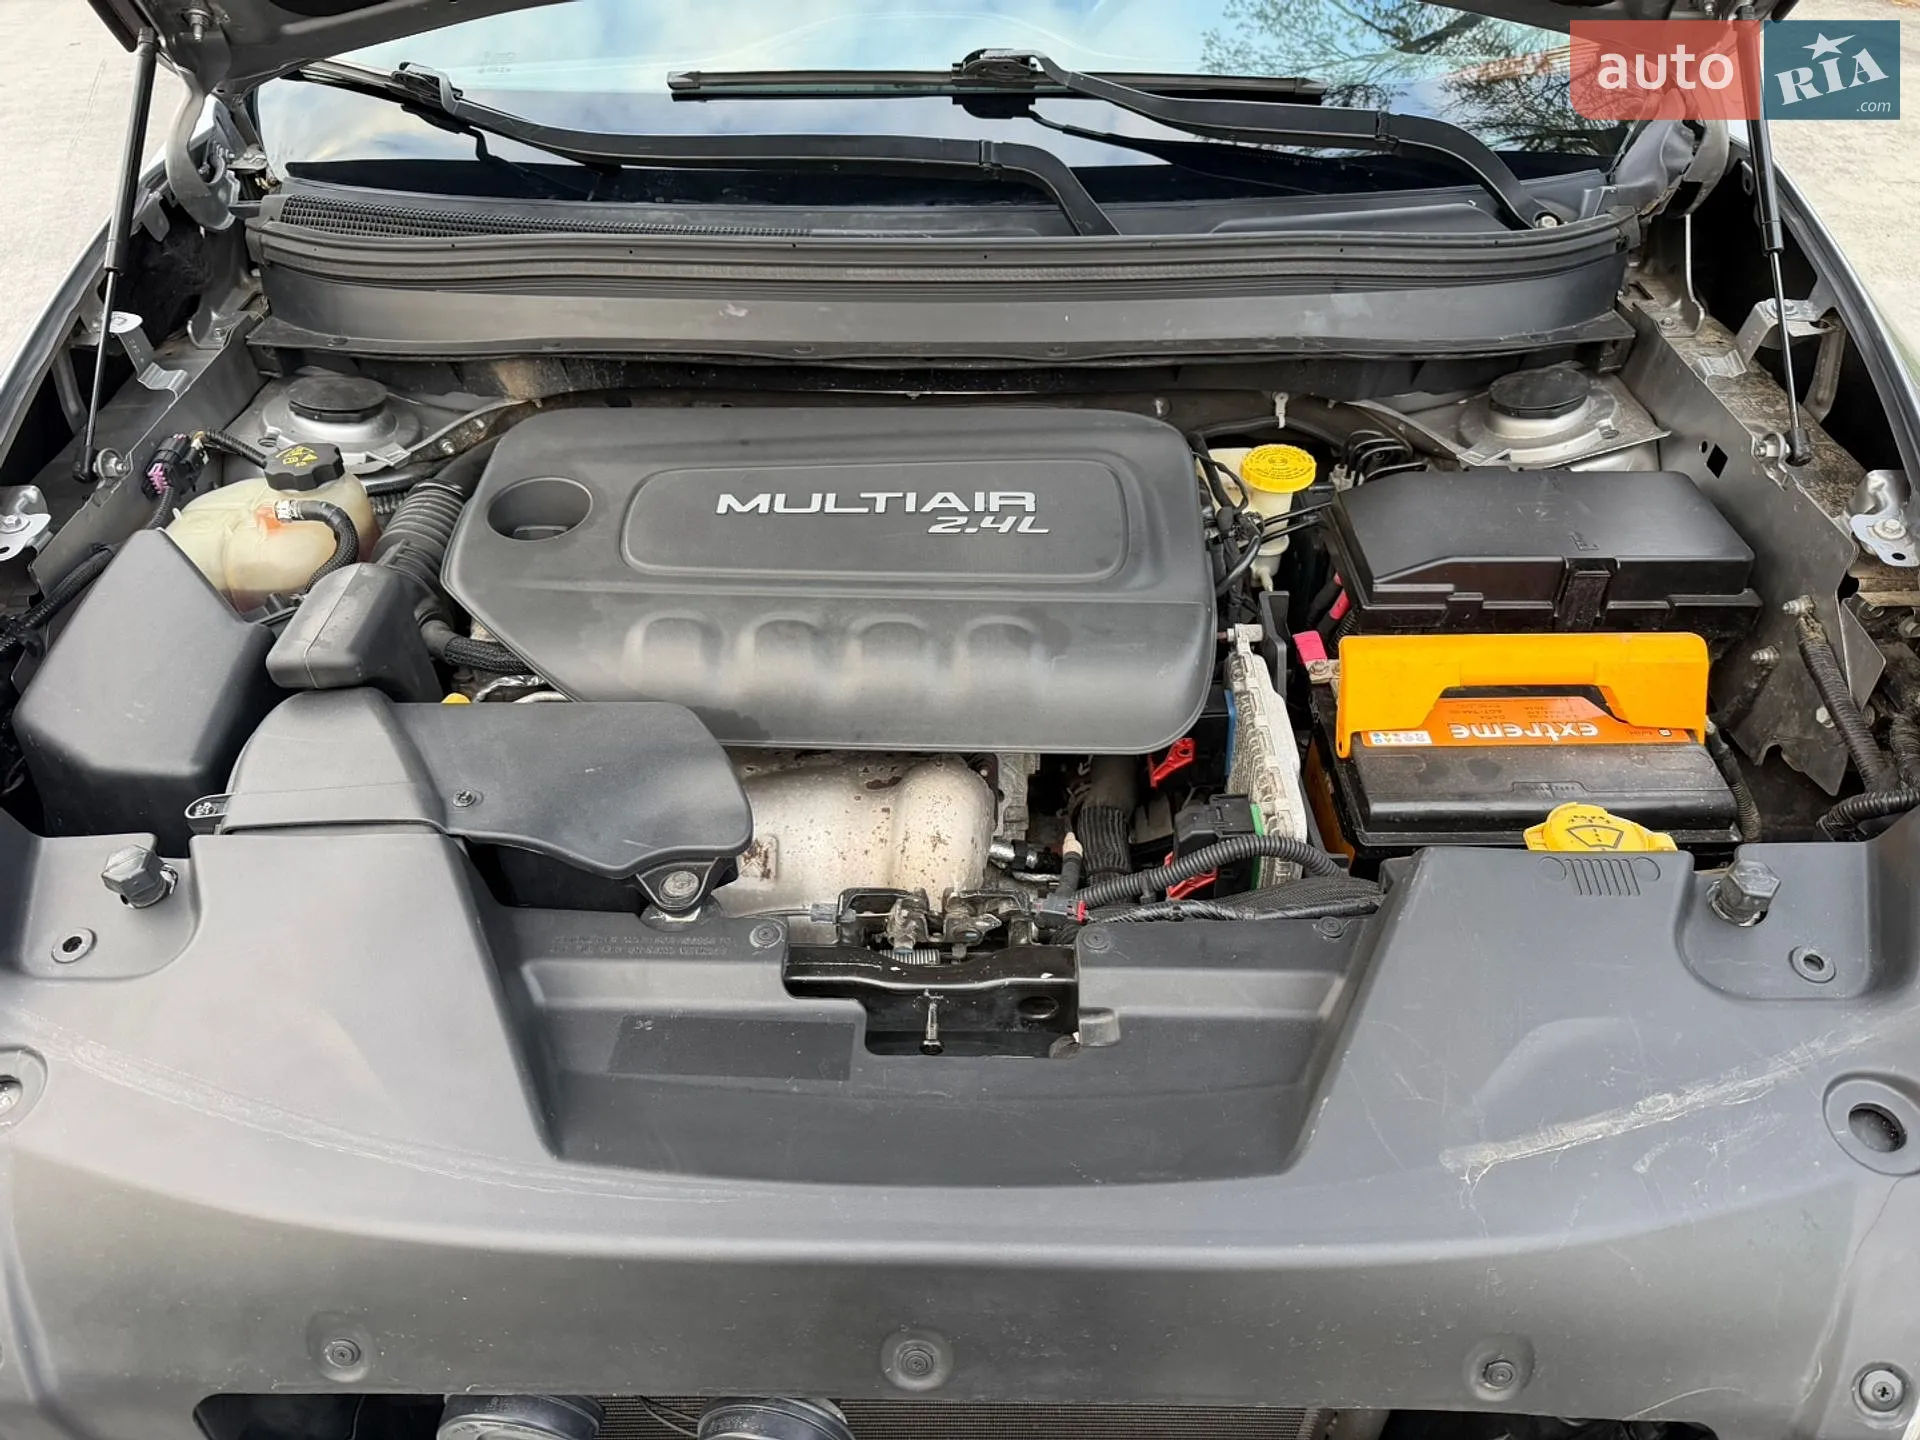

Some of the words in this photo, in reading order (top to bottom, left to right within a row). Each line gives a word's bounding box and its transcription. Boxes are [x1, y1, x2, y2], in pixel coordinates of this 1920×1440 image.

[715, 491, 1037, 514] MULTIAIR
[928, 516, 1050, 534] 2.4L
[1450, 722, 1599, 743] extreme
